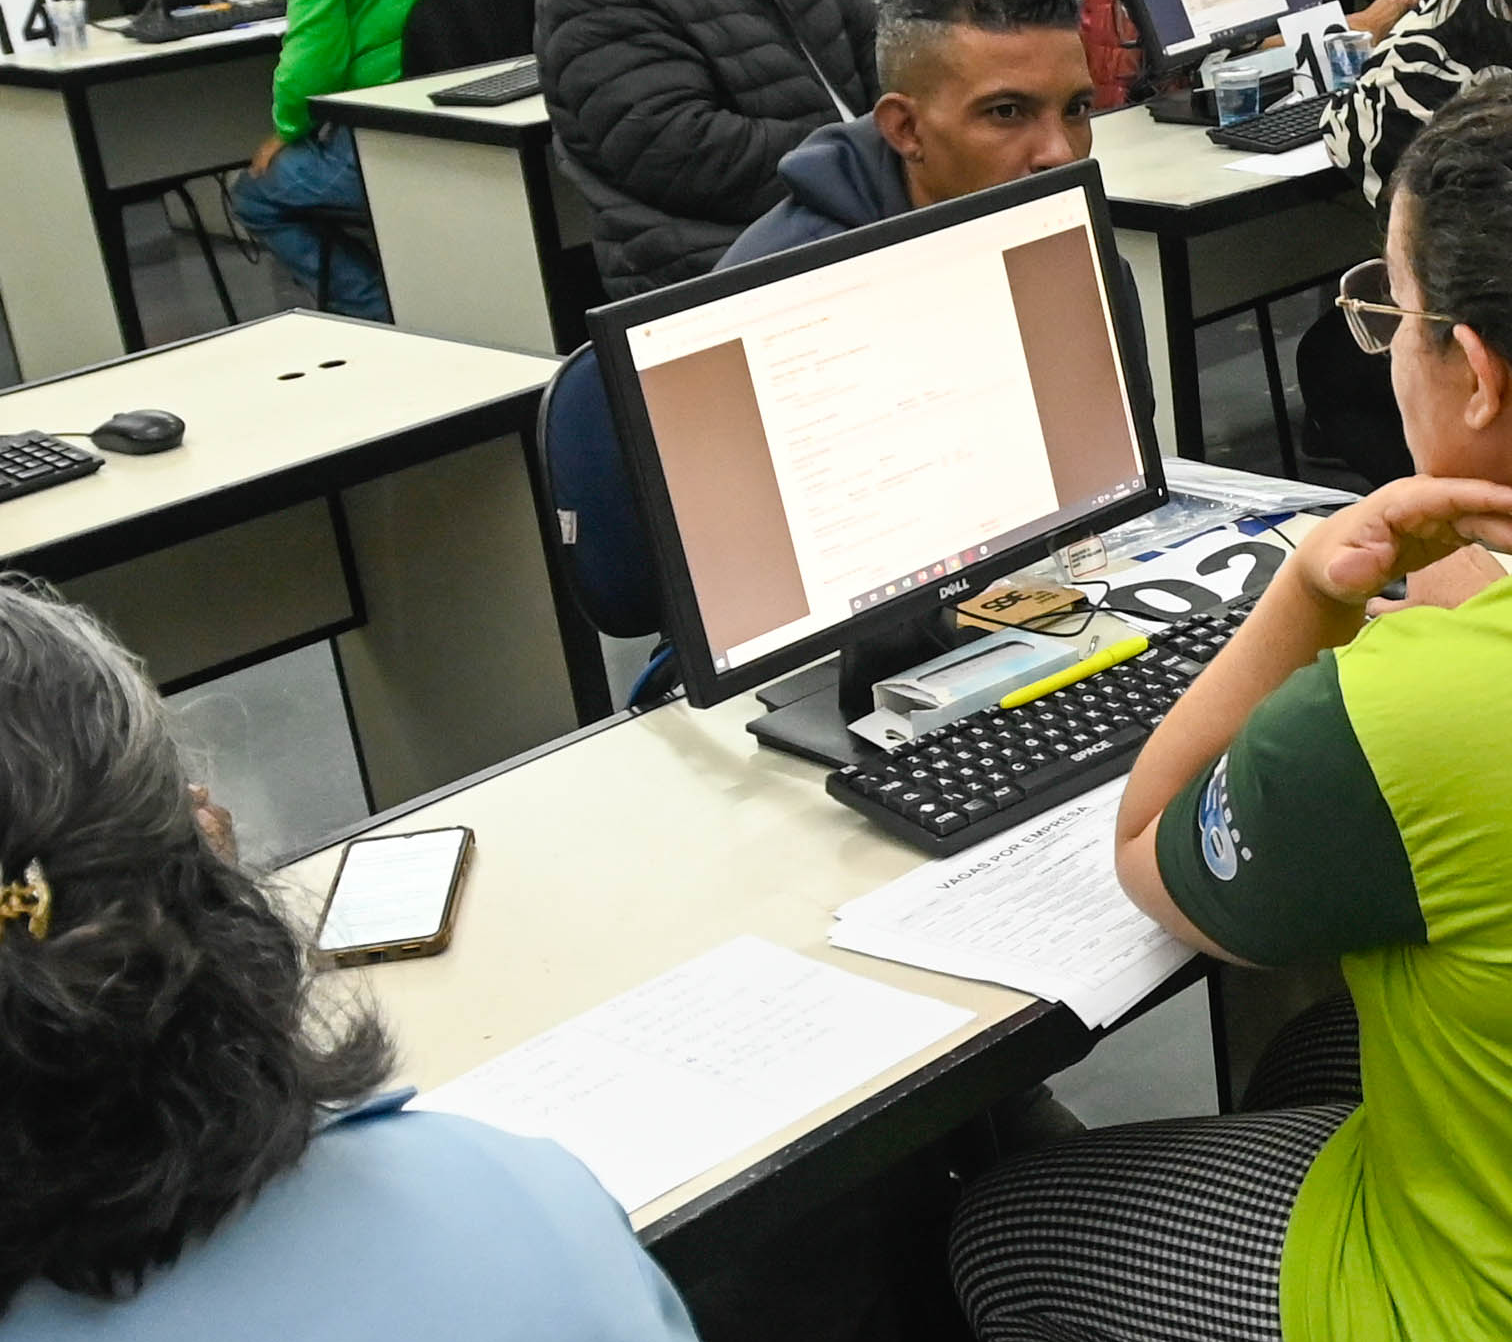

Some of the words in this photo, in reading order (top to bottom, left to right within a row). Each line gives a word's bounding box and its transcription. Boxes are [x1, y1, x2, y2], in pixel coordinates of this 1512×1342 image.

[938, 578, 971, 600] DELL
[1103, 540, 1287, 626] 02
[1069, 739, 1114, 762] SPACE
[935, 861, 992, 891] VAGAS
[989, 842, 1025, 862] POR
[1020, 805, 1089, 844] EMPRESA
